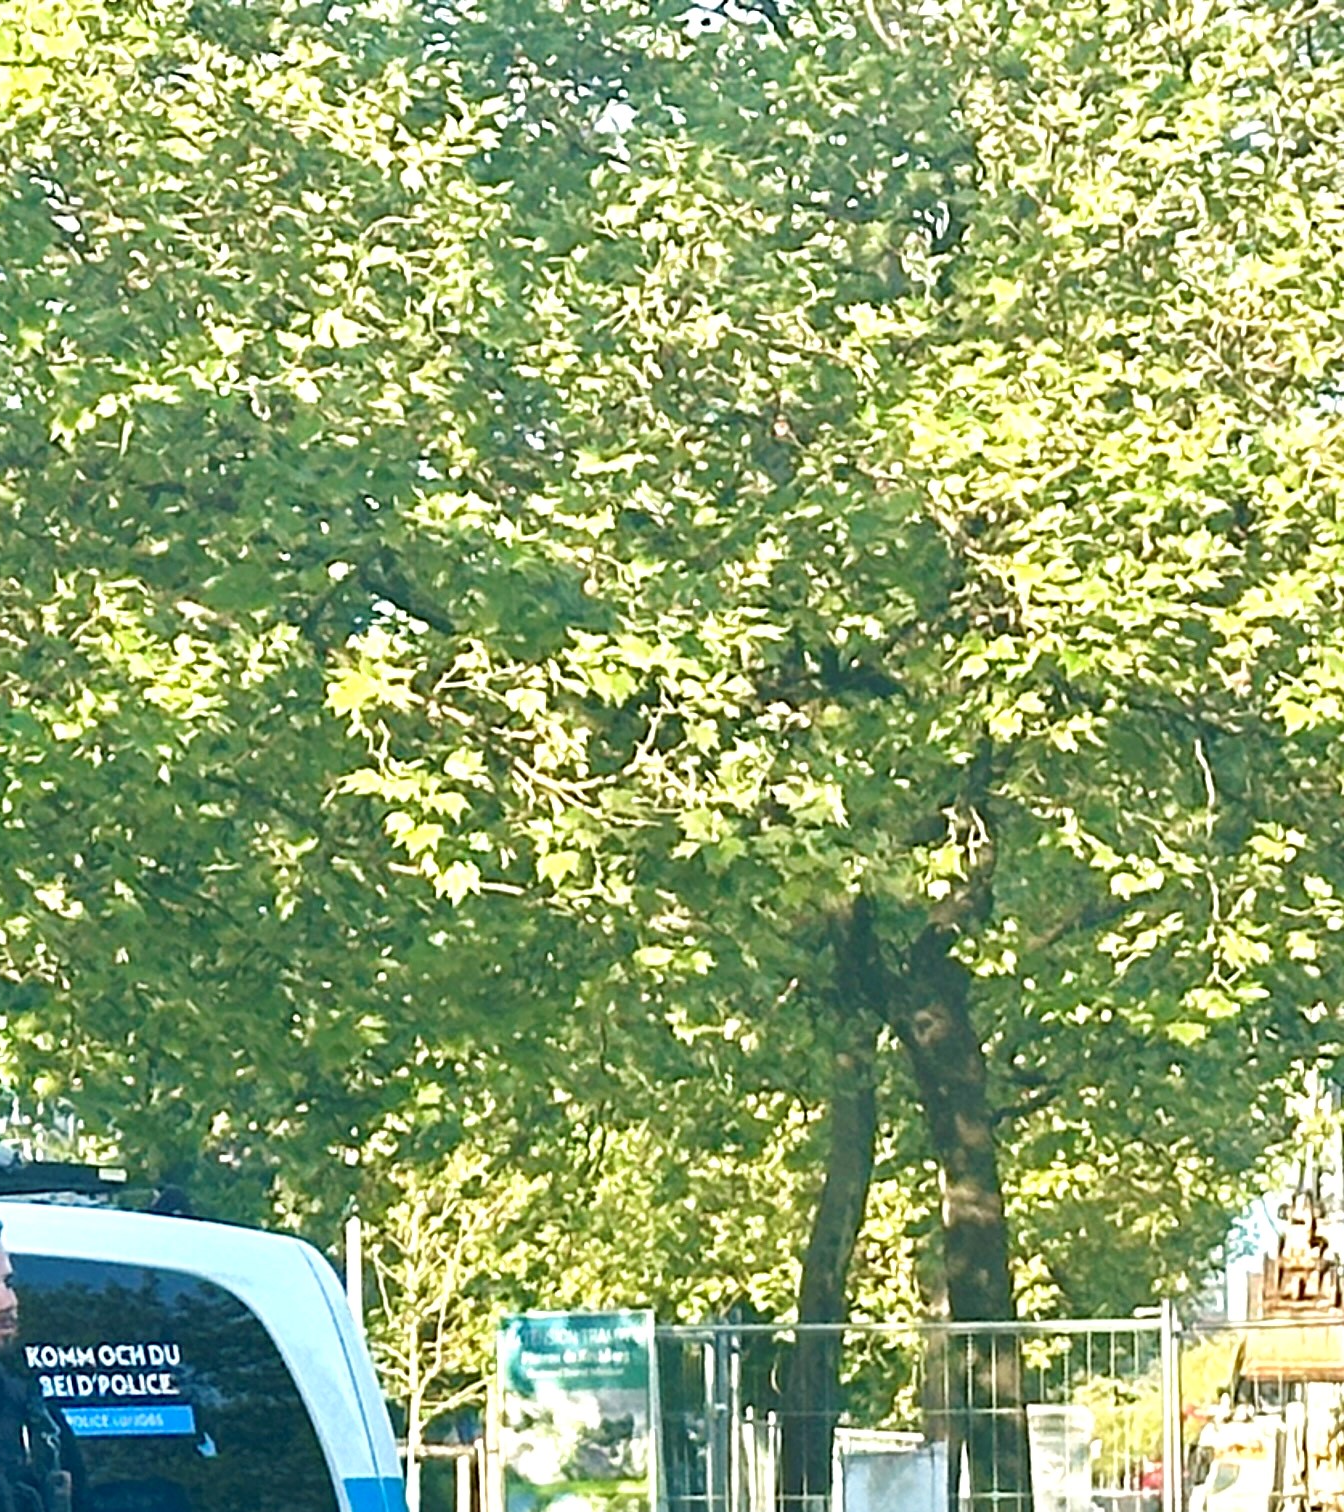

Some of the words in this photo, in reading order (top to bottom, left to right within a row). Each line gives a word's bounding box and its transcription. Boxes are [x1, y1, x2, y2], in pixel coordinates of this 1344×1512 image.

[25, 1346, 96, 1368] KOMM
[98, 1344, 146, 1366] OCH
[147, 1344, 180, 1366] DU
[39, 1375, 74, 1397] BEI
